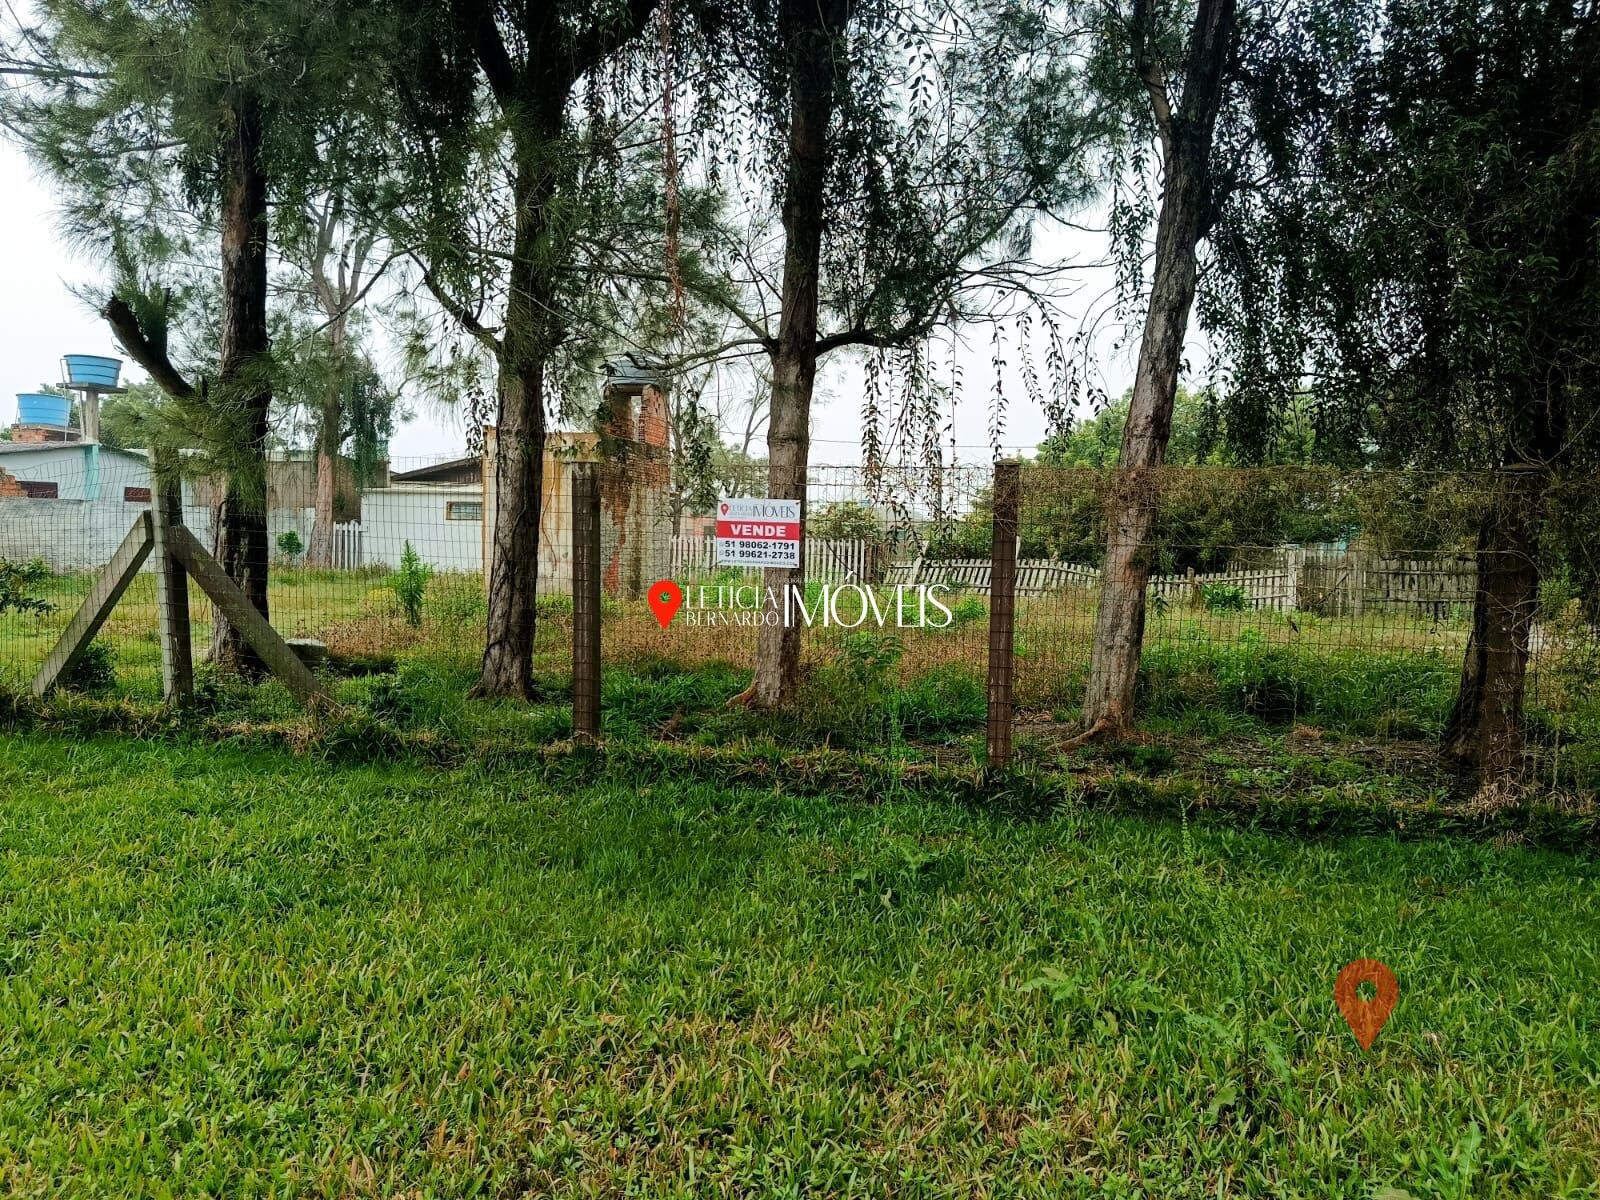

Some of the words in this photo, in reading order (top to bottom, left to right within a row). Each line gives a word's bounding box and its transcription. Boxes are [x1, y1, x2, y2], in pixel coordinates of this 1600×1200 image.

[730, 524, 786, 537] VENDE
[739, 541, 795, 550] 98062-1791
[739, 550, 795, 559] 99621-2738
